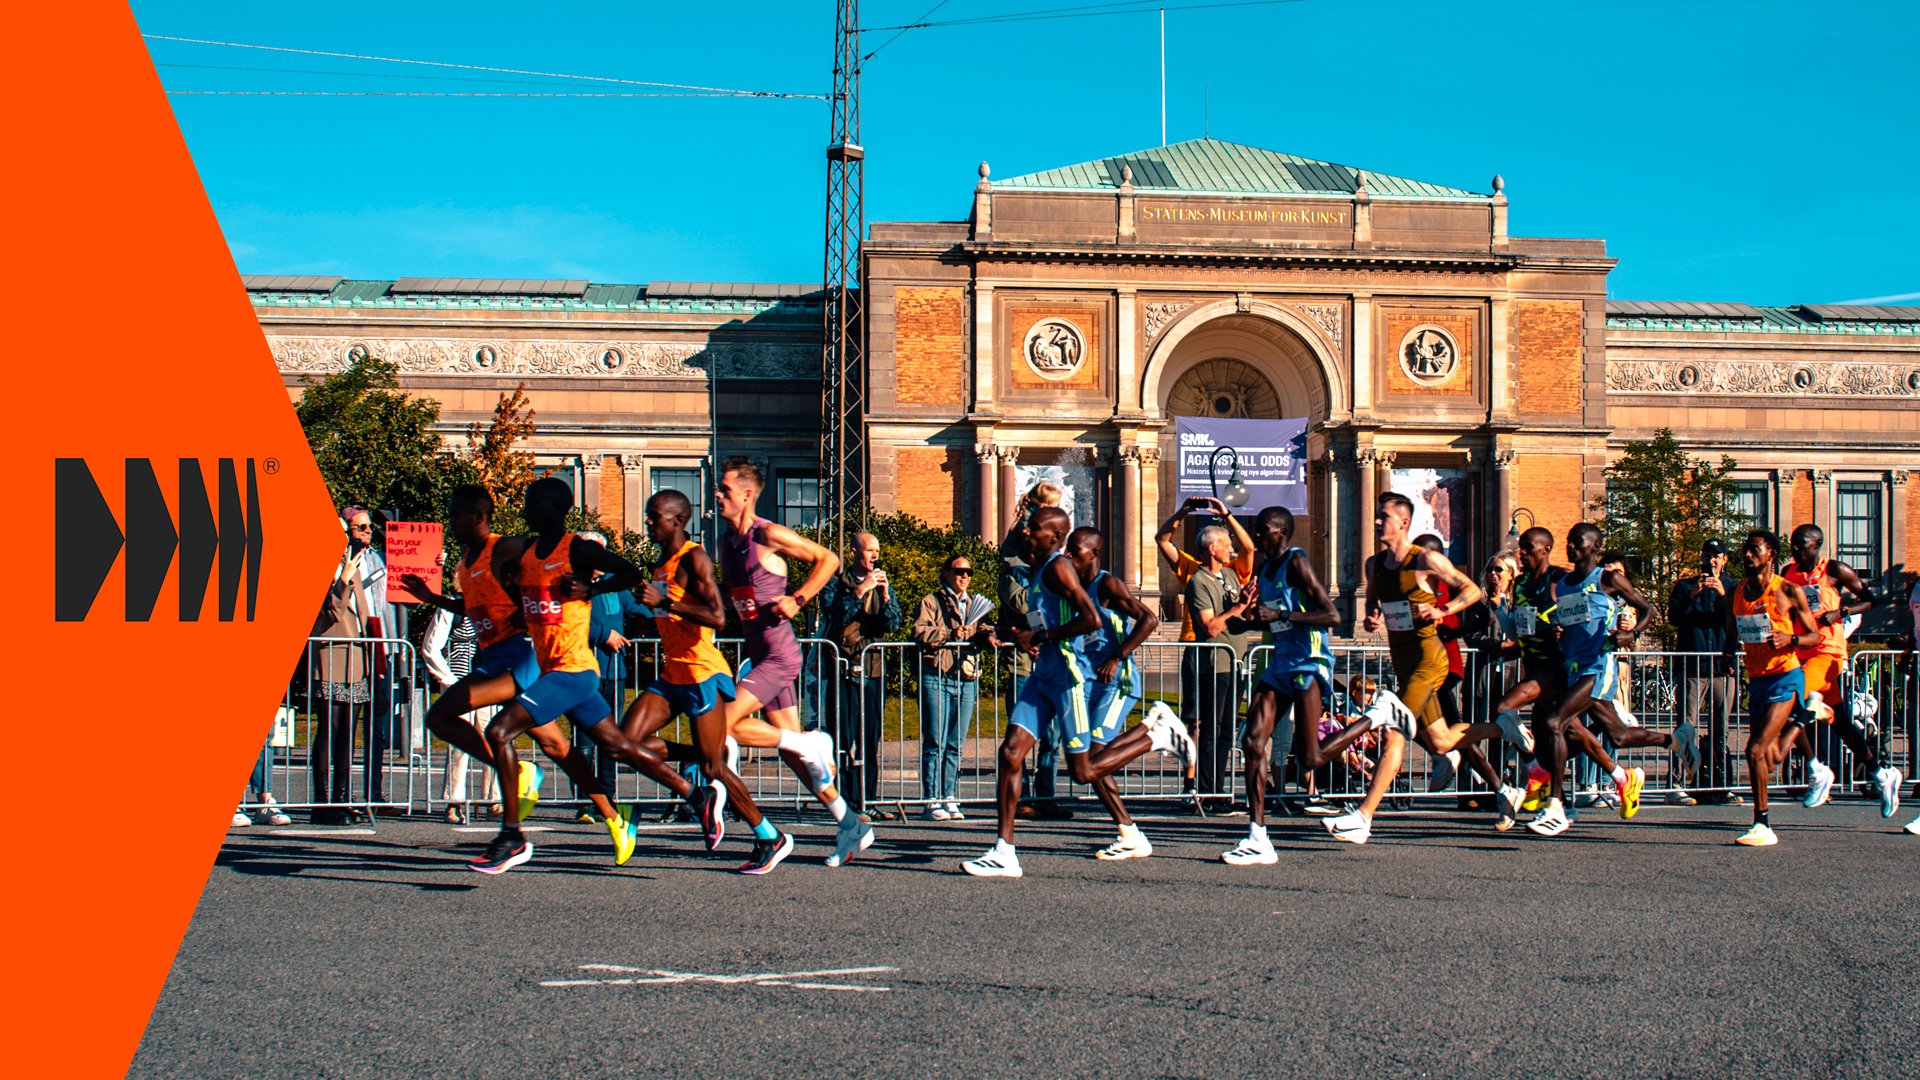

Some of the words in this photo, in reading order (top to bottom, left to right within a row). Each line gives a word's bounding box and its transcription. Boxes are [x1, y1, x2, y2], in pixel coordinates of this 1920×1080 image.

[1143, 205, 1205, 221] STATENS
[1210, 207, 1268, 222] MUSEUM
[1272, 209, 1297, 223] FOR
[1301, 209, 1346, 224] KUNST
[1187, 454, 1236, 466] AGANST
[1238, 455, 1257, 466] ALL
[1260, 455, 1290, 467] ODDS
[1186, 468, 1217, 476] Historis
[1260, 469, 1290, 477] algoritmer
[388, 538, 403, 546] Run
[404, 539, 422, 547] your
[388, 547, 404, 556] legs
[405, 547, 418, 555] off.
[388, 565, 404, 573] Pick
[522, 596, 562, 614] Pace
